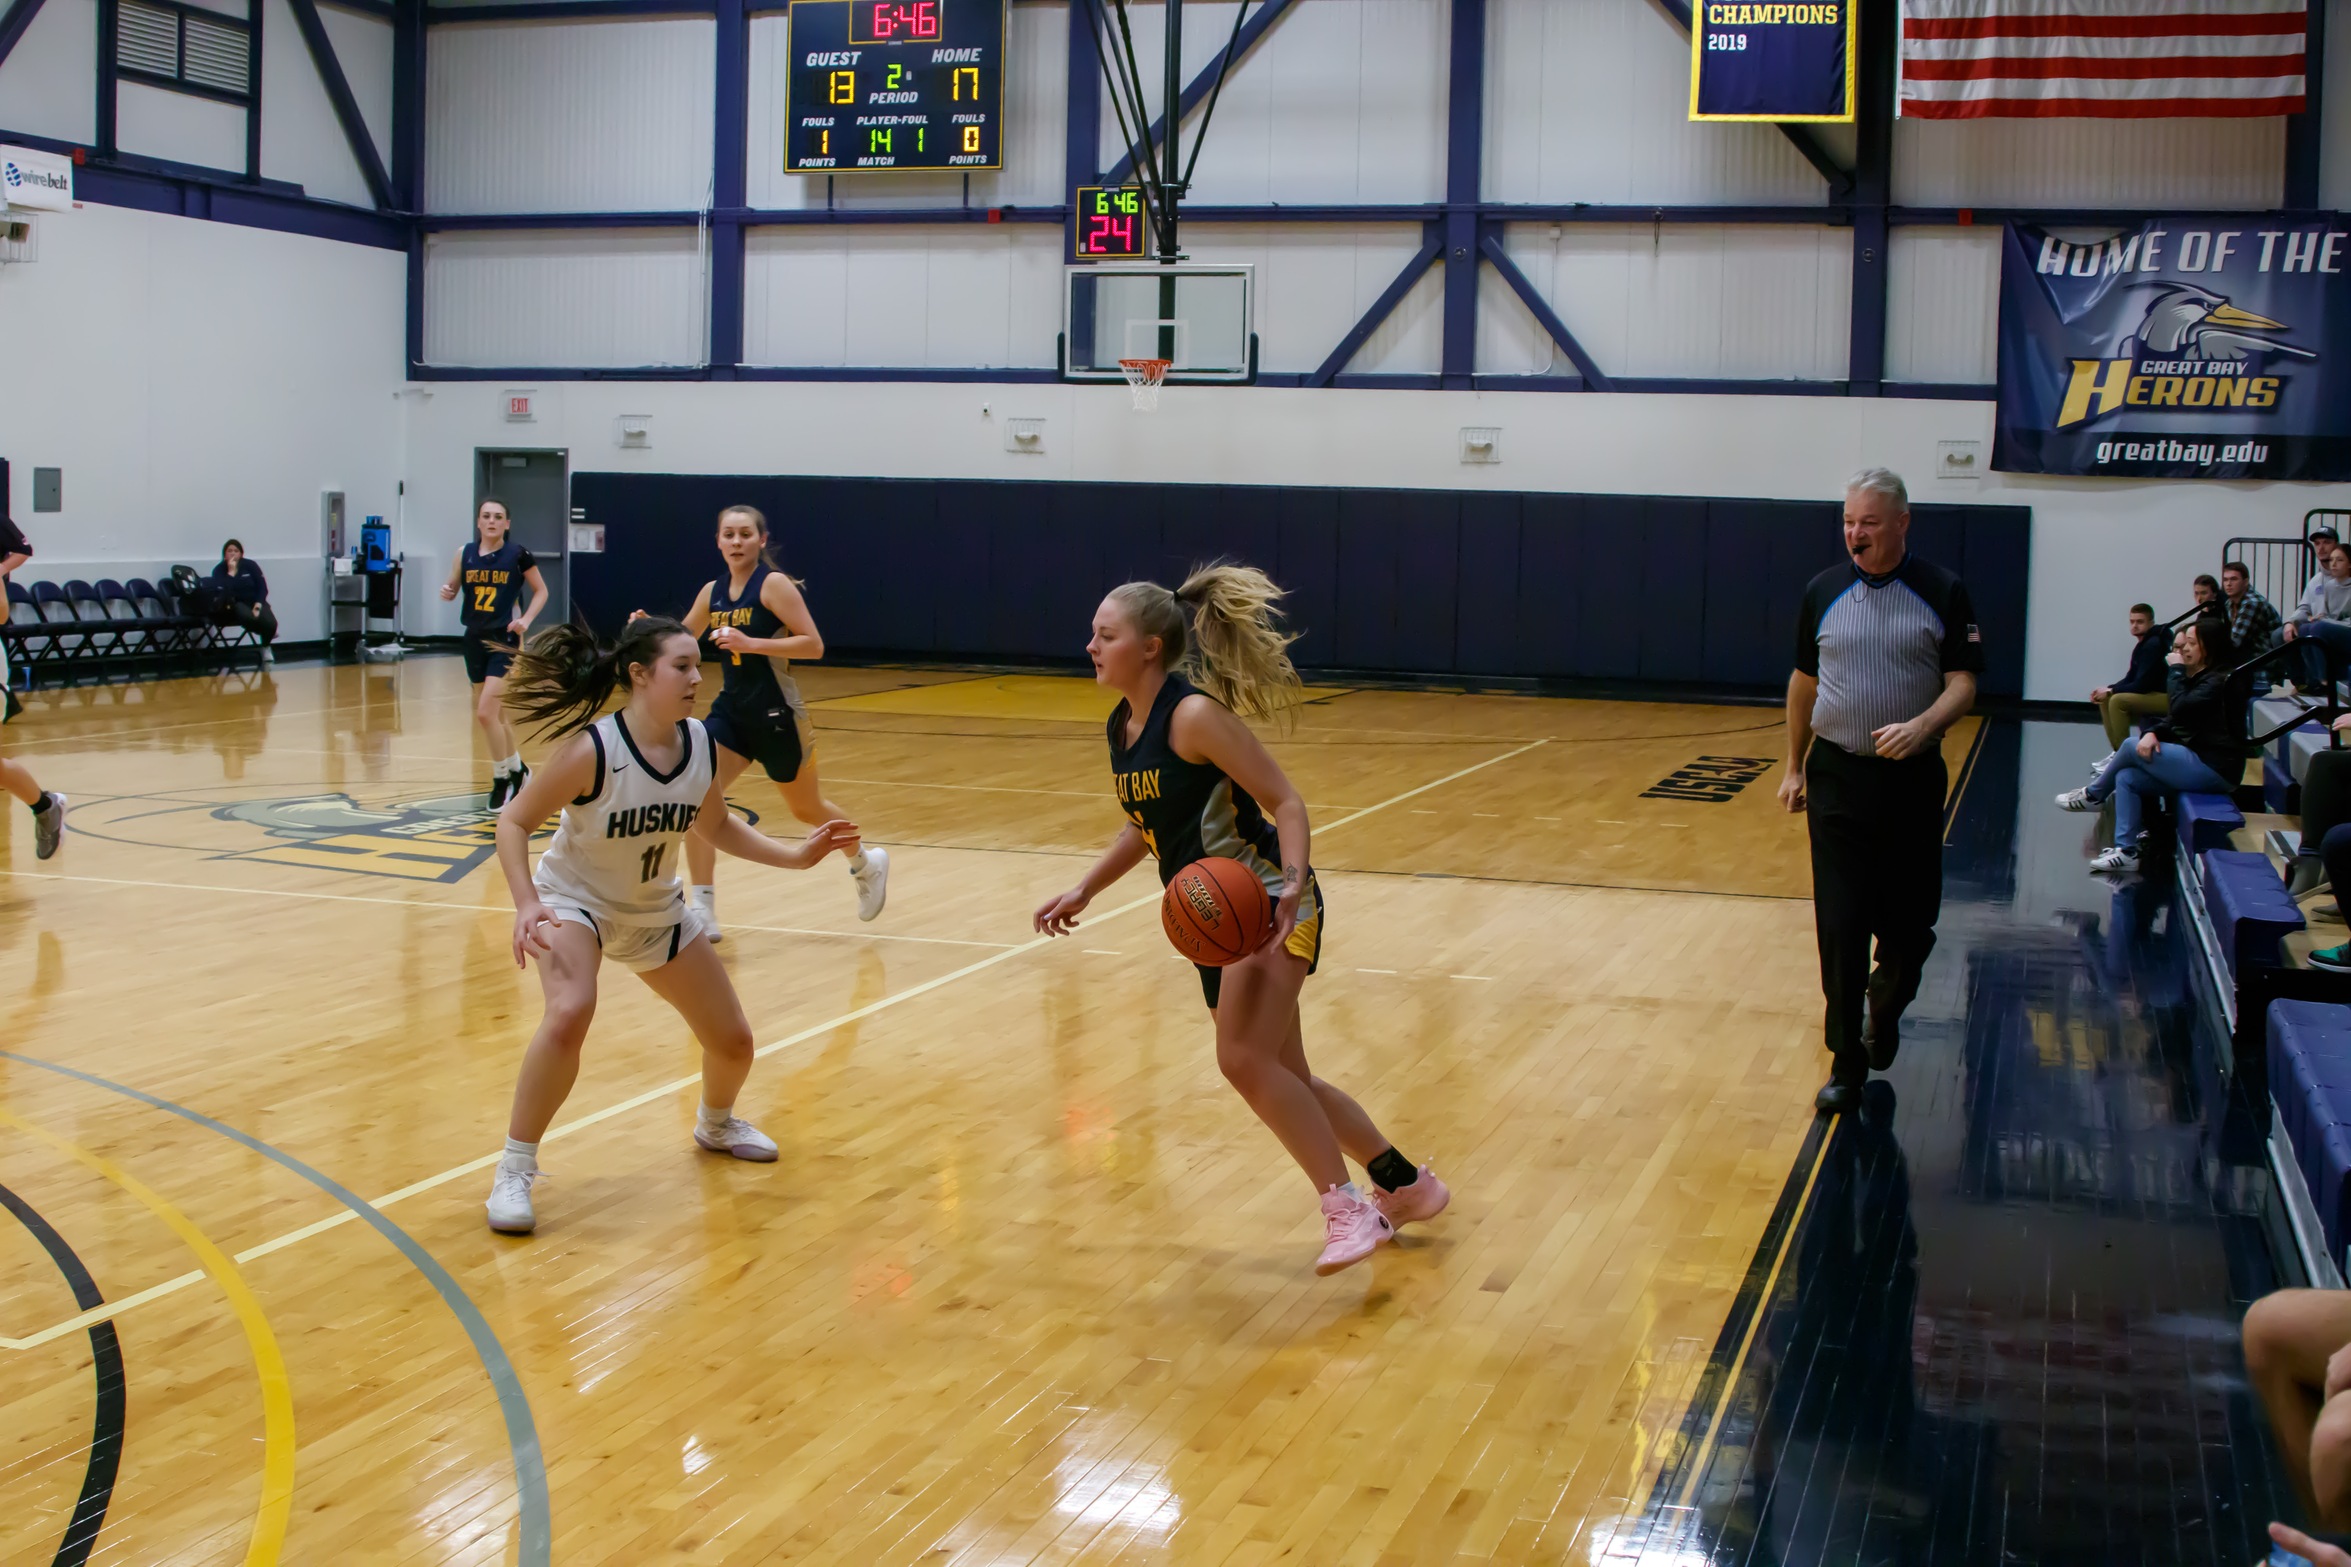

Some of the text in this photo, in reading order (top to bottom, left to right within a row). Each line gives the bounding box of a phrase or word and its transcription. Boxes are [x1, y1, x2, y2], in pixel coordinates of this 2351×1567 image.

[873, 2, 936, 37] 6:46
[1709, 4, 1838, 24] CHAMPIONS
[1708, 33, 1747, 50] 2019
[806, 51, 862, 66] GUEST
[931, 48, 982, 63] HOME
[886, 63, 902, 89] 2
[952, 67, 979, 101] 17
[829, 70, 855, 104] 13
[869, 91, 919, 104] PERIOD
[802, 117, 835, 127] FOULS
[856, 115, 929, 125] PLAYER-FOUL
[952, 113, 985, 123] FOULS
[821, 129, 829, 154] 1
[870, 127, 924, 153] 14 1
[963, 126, 980, 152] 0
[799, 157, 836, 167] POINTS
[857, 156, 895, 166] MATCH
[949, 154, 987, 164] POINTS
[1089, 215, 1132, 252] 24
[2036, 231, 2348, 277] HOME OF THE
[2140, 360, 2249, 375] GREAT BAY
[2056, 359, 2280, 428] HERONS
[511, 397, 528, 413] EXIT
[2096, 440, 2269, 466] greatbay.edu
[466, 569, 509, 584] GREAT BAY
[474, 586, 497, 612] 22
[732, 607, 753, 627] BAY
[1131, 768, 1161, 802] BAY
[640, 842, 667, 884] 11
